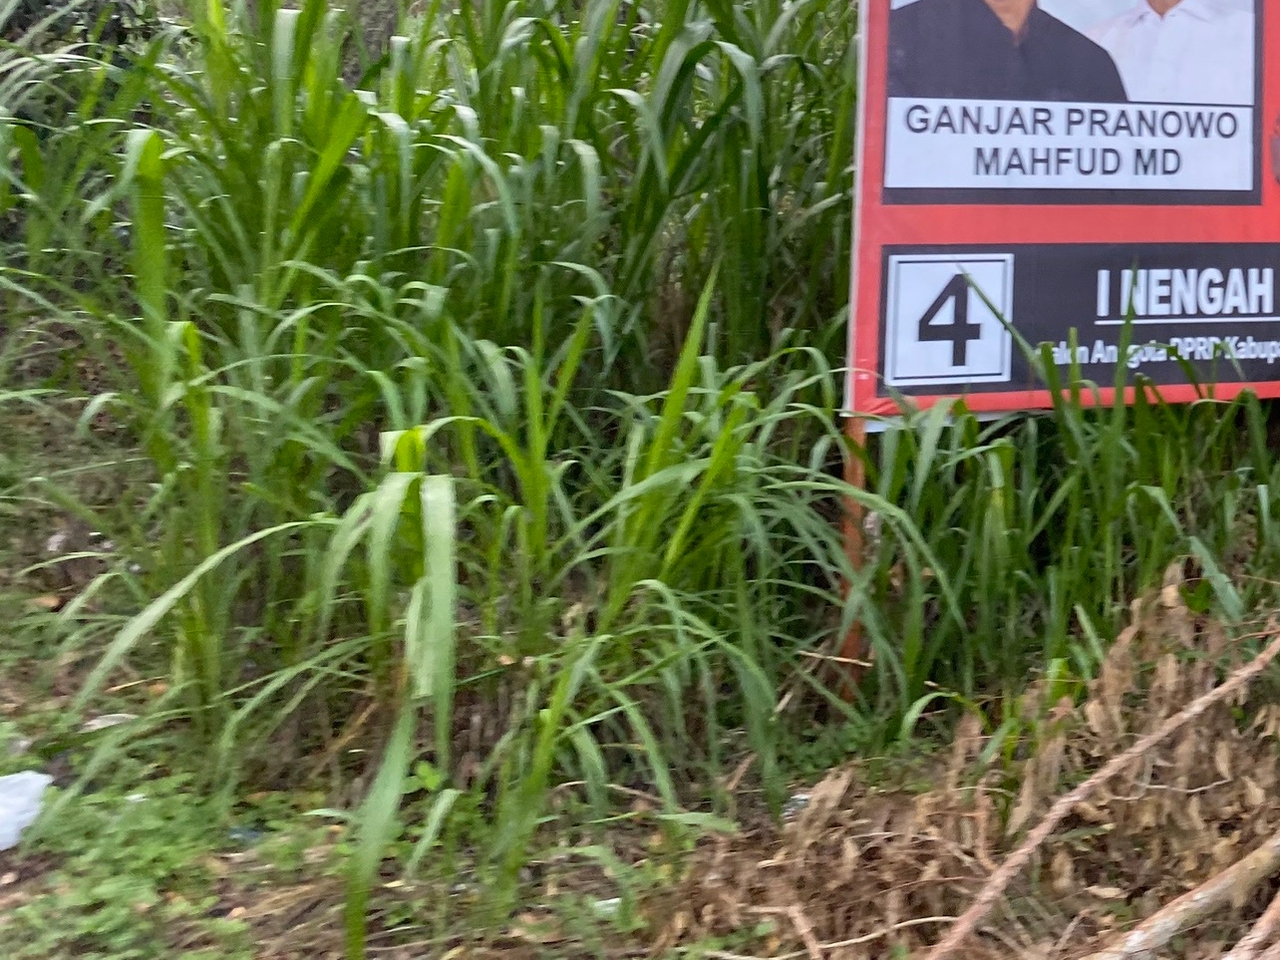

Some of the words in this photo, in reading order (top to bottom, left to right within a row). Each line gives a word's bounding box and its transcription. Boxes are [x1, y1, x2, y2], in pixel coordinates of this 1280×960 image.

[906, 104, 1055, 136] GANJAR
[1066, 108, 1238, 139] PRANOWO
[974, 147, 1121, 176] MAHFUD
[1134, 148, 1181, 176] MD
[1097, 269, 1110, 317] I
[1121, 267, 1274, 316] NENGAH
[917, 273, 983, 367] 4
[1091, 339, 1167, 368] Angota
